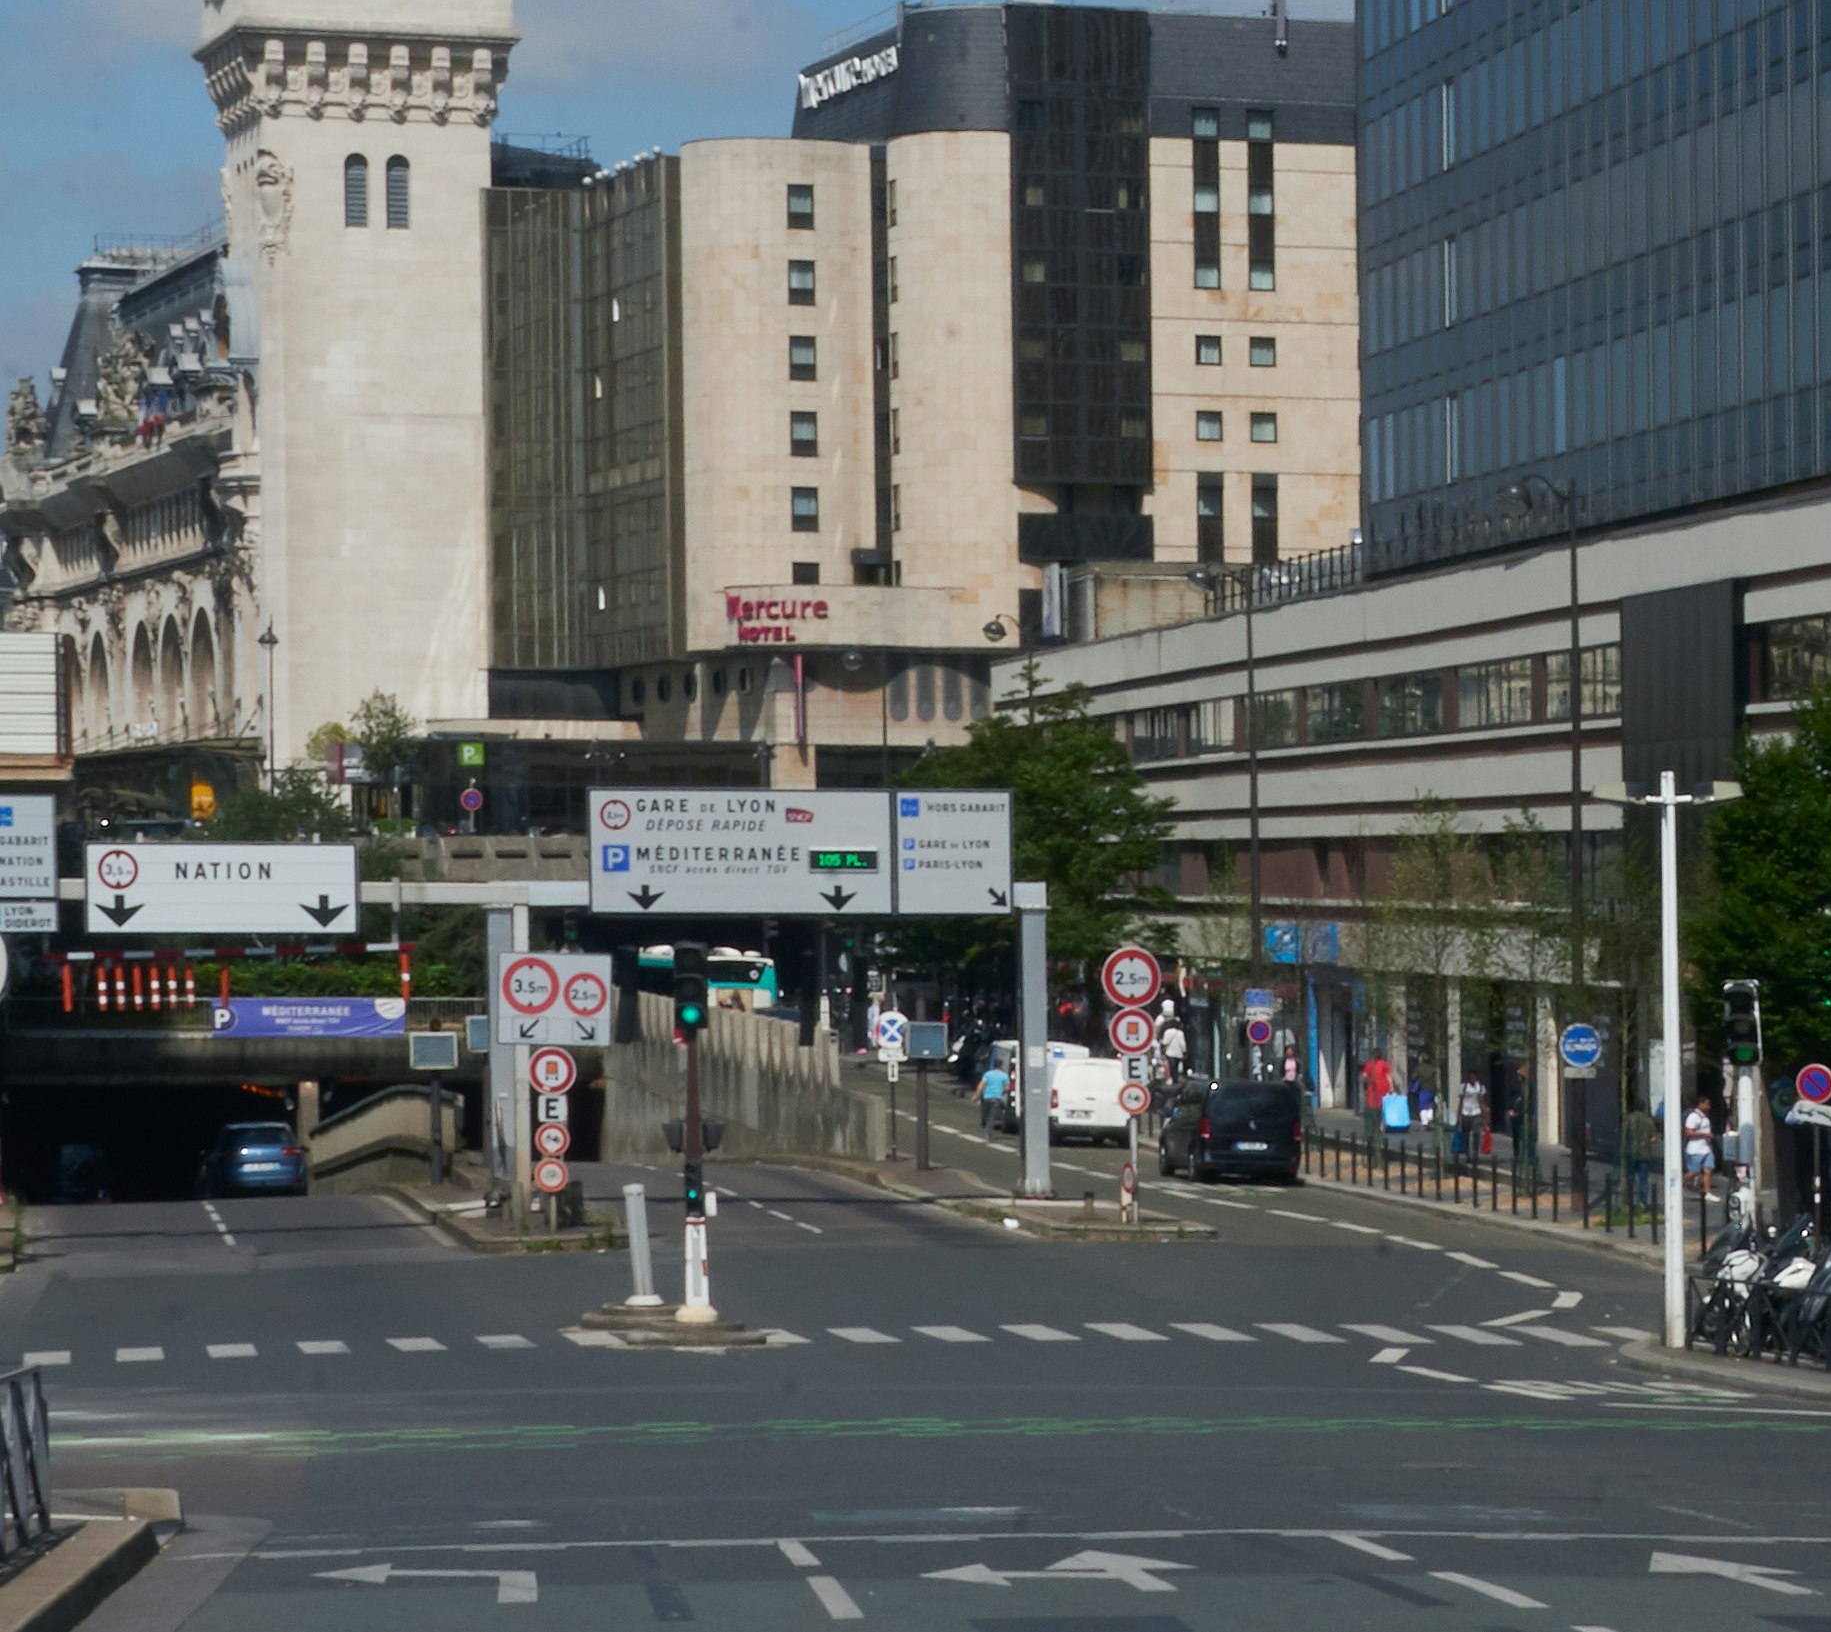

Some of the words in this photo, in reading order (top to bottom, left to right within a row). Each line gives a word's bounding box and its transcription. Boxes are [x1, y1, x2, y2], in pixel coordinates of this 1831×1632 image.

[725, 592, 829, 621] Mercure
[636, 798, 688, 813] GARE
[700, 803, 716, 813] DE
[727, 798, 776, 813] LYON
[711, 819, 766, 832] RAPIDE
[636, 844, 800, 861] MÉDITERRANÉE
[962, 839, 991, 849] LYON
[607, 847, 625, 870] P
[818, 853, 841, 867] 105
[175, 862, 272, 880] NATION
[214, 1008, 231, 1030] P
[1128, 1058, 1141, 1079] E
[545, 1098, 559, 1120] E
